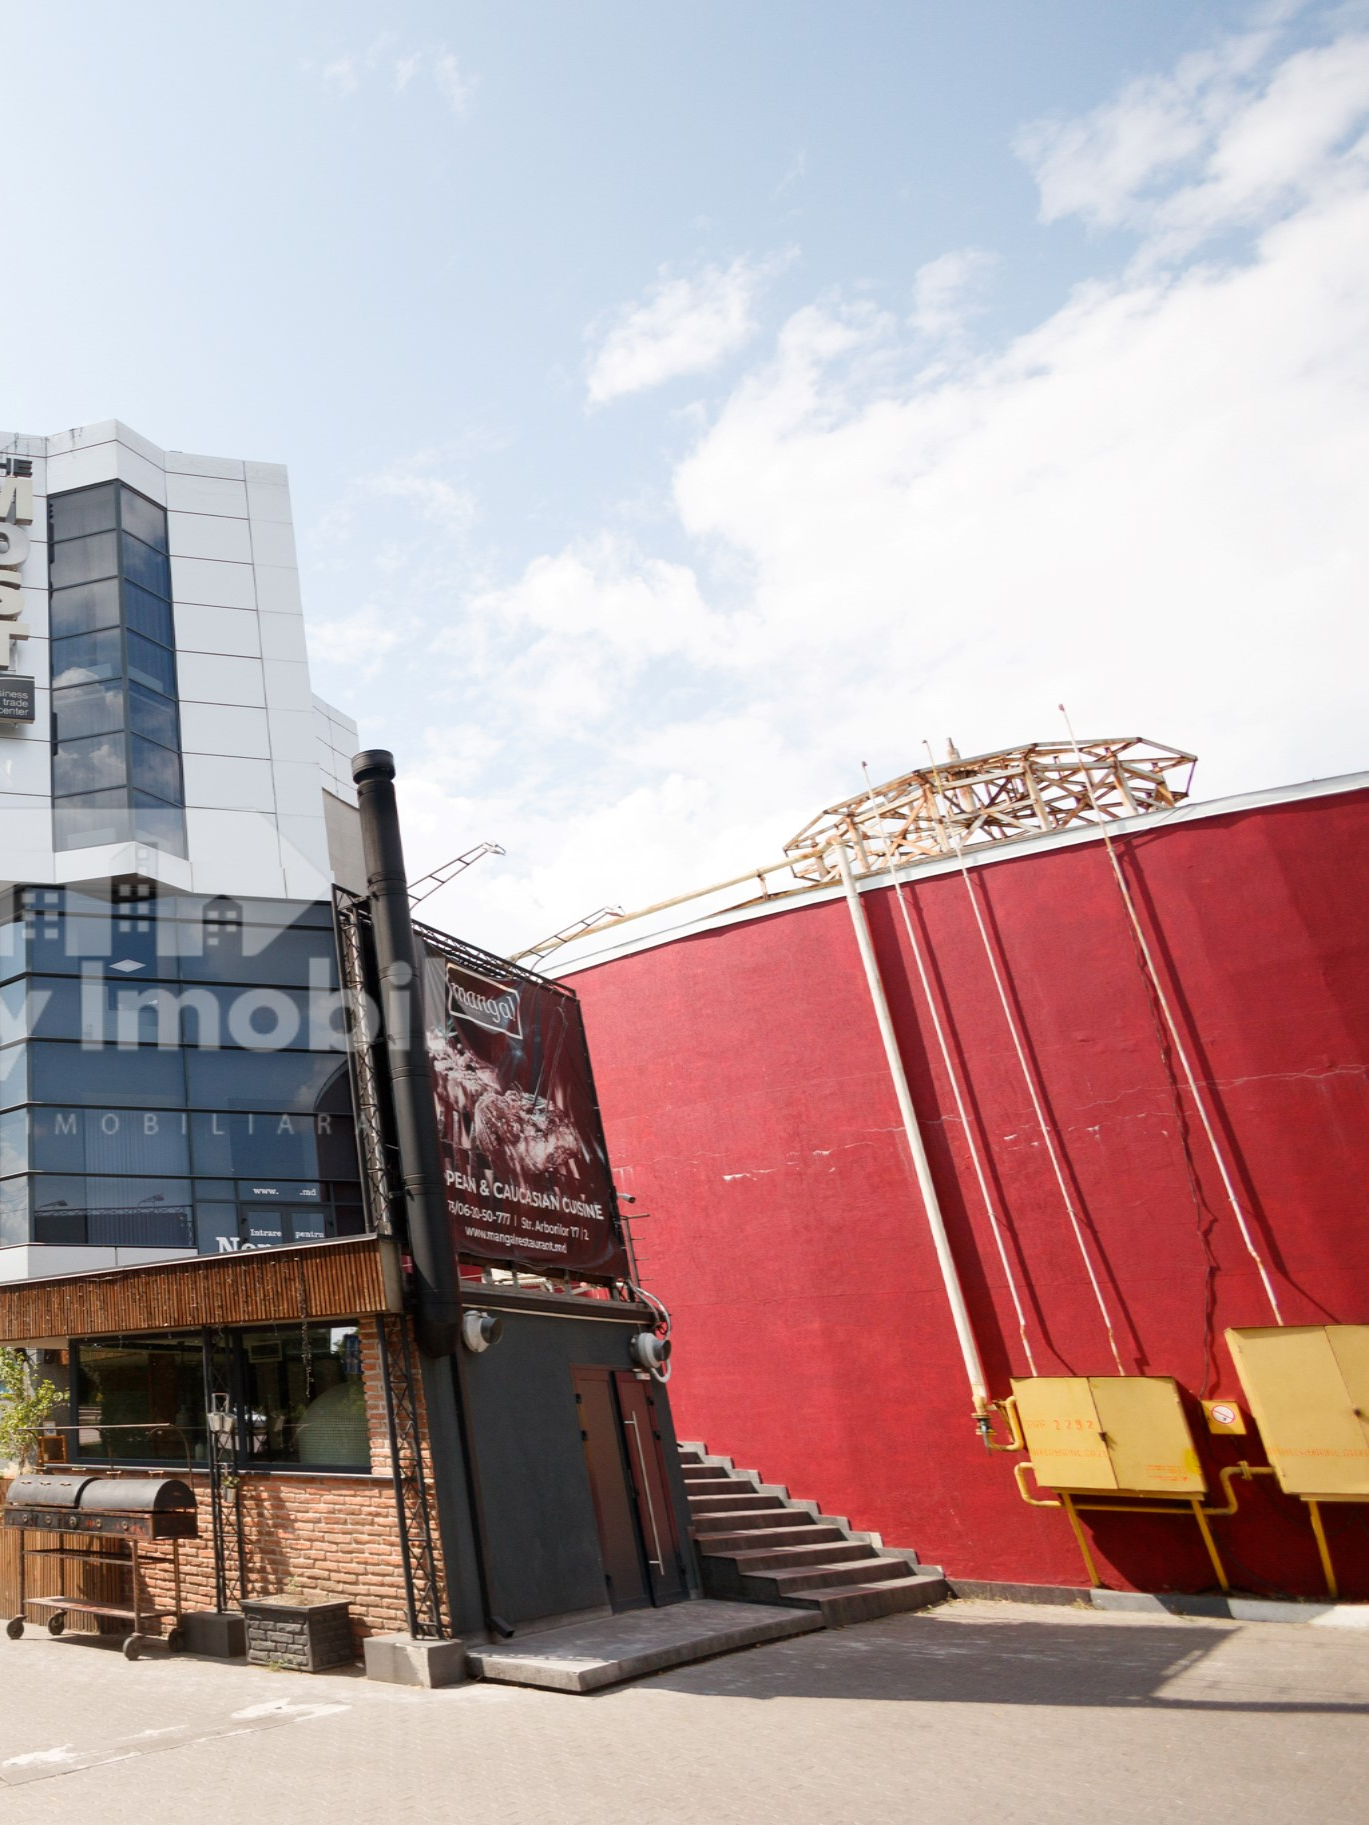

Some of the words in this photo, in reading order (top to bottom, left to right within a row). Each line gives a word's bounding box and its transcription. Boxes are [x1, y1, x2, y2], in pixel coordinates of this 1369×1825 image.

[3, 698, 29, 708] trade
[451, 982, 516, 1022] mangal
[445, 1170, 476, 1193] PEAN
[479, 1179, 490, 1197] &
[493, 1182, 560, 1211] CAUCASIAN
[562, 1196, 605, 1220] CUISINE
[250, 1229, 282, 1237] Intrare
[294, 1230, 326, 1239] pentru
